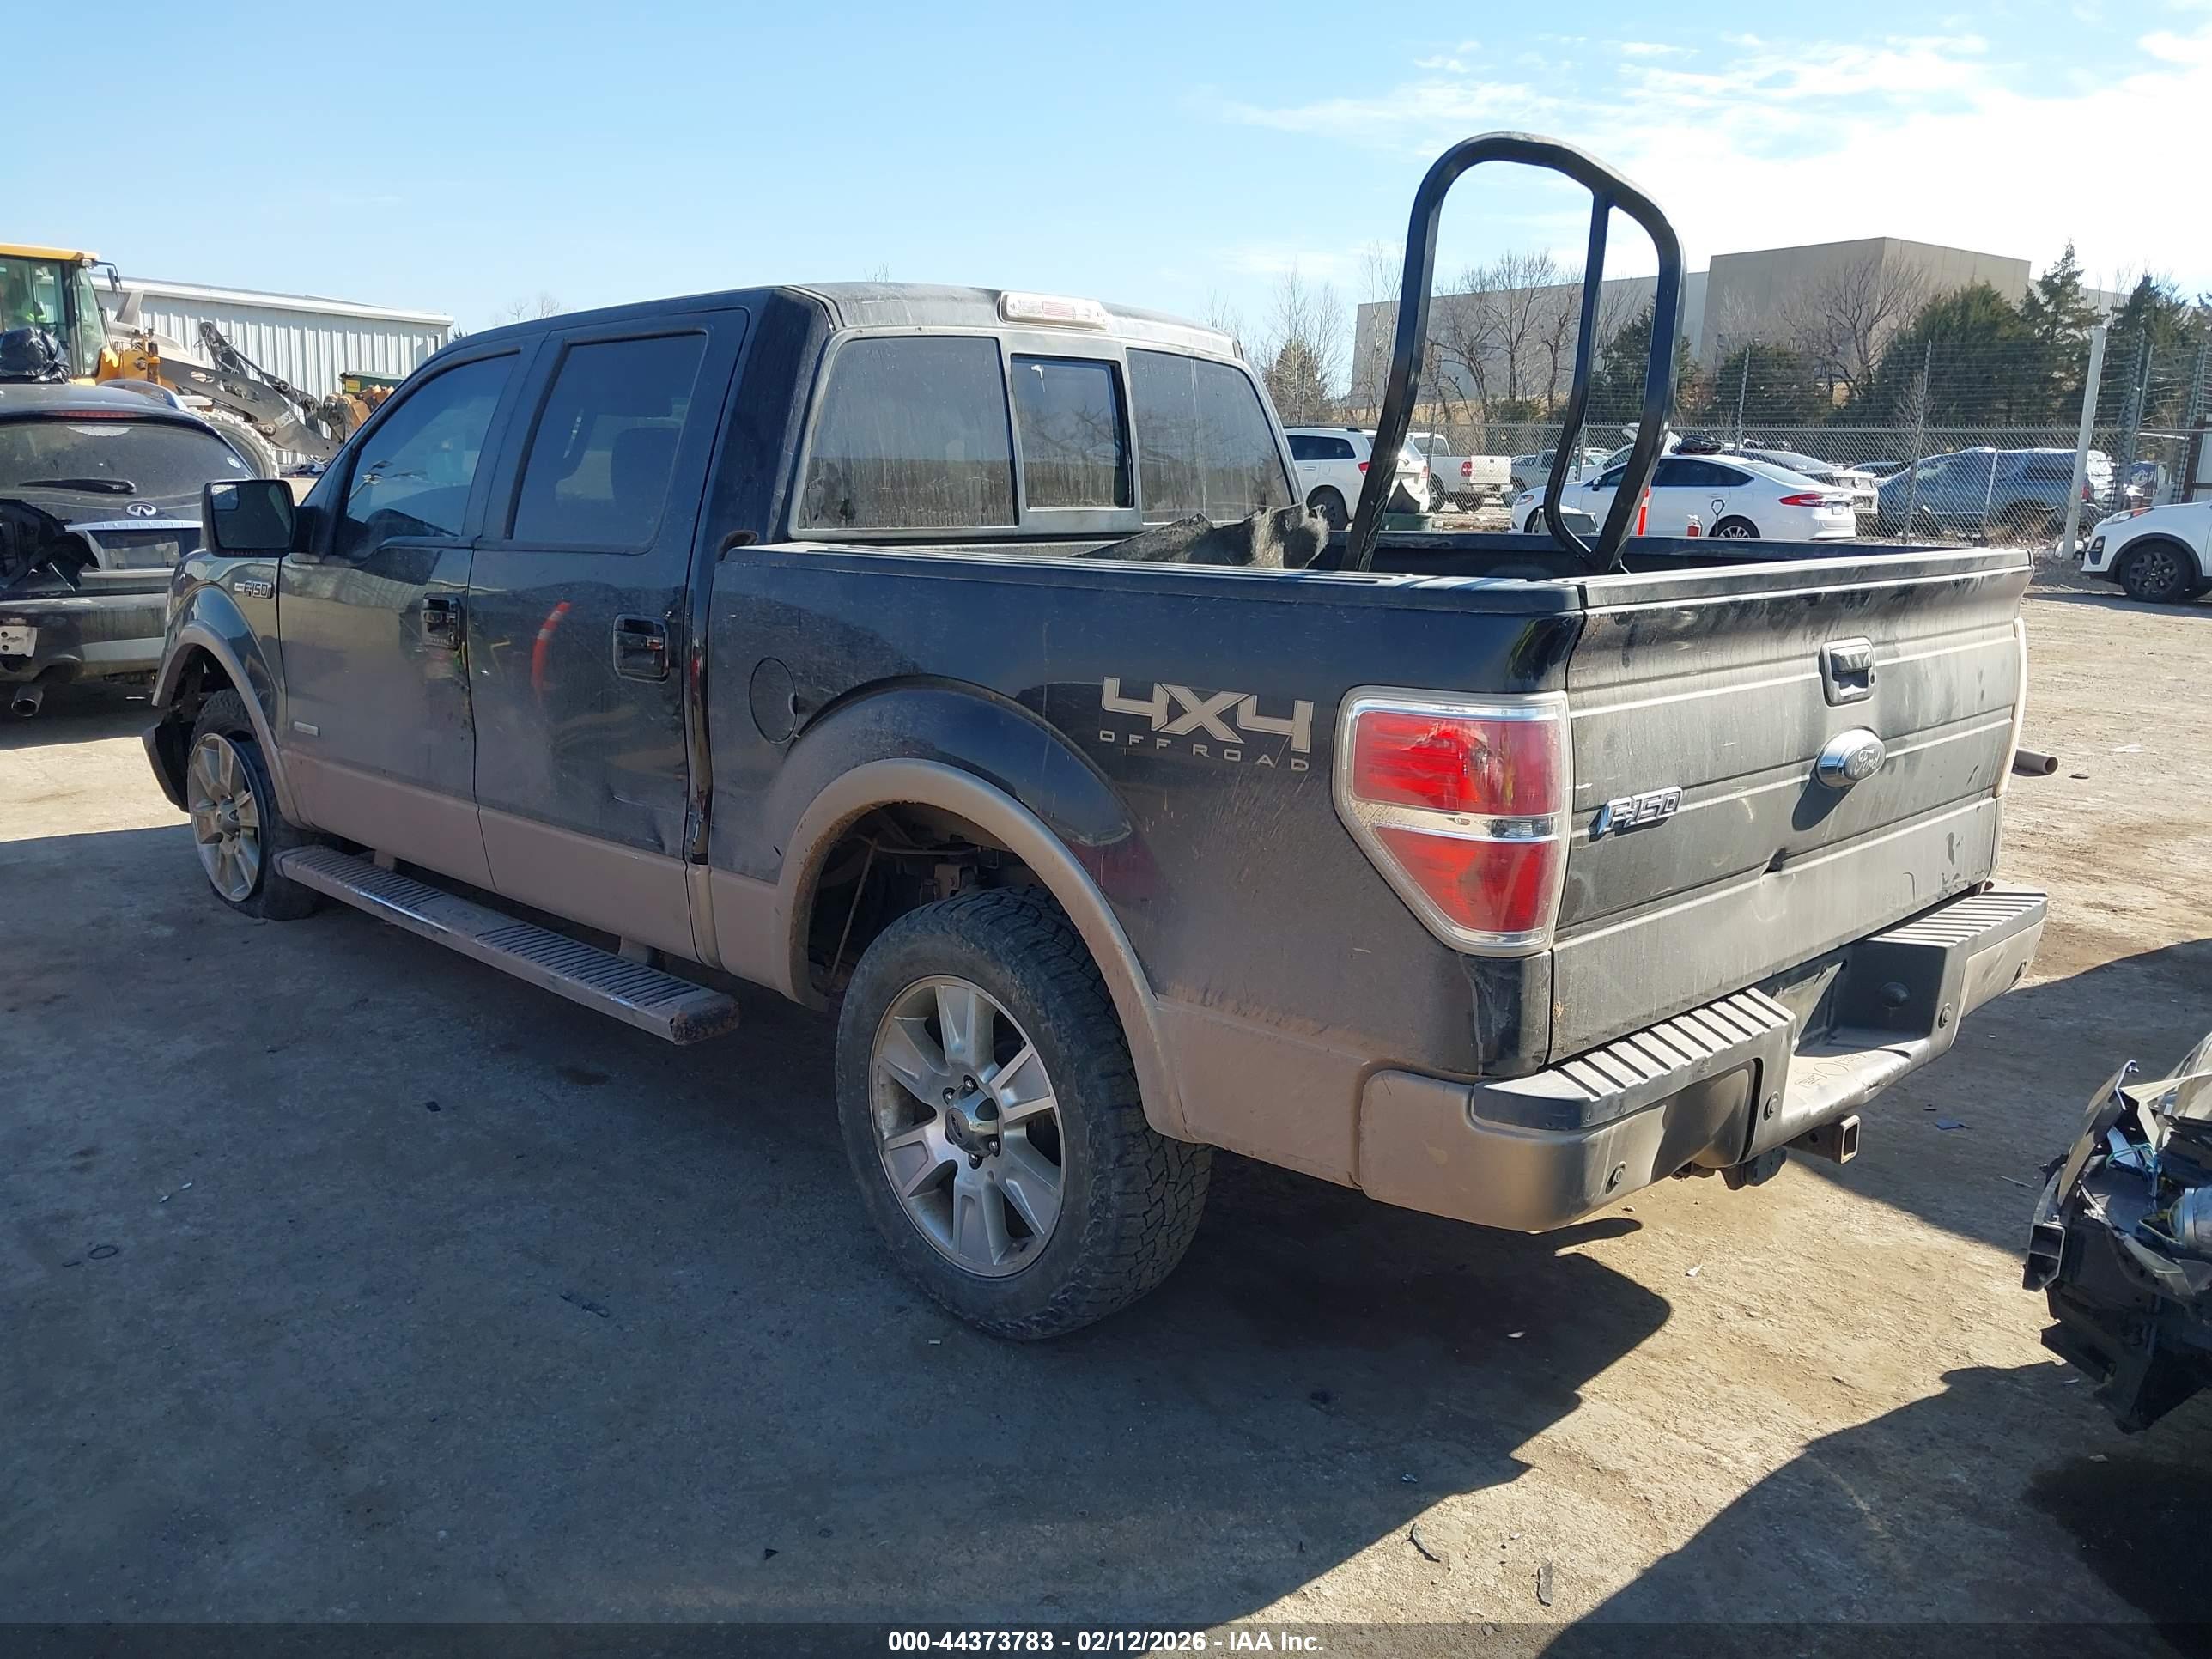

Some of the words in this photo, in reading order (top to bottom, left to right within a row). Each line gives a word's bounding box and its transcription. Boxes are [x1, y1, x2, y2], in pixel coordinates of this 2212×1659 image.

[1099, 729, 1172, 750] OFF
[1192, 743, 1310, 772] ROAD
[1854, 748, 1881, 775] Ford
